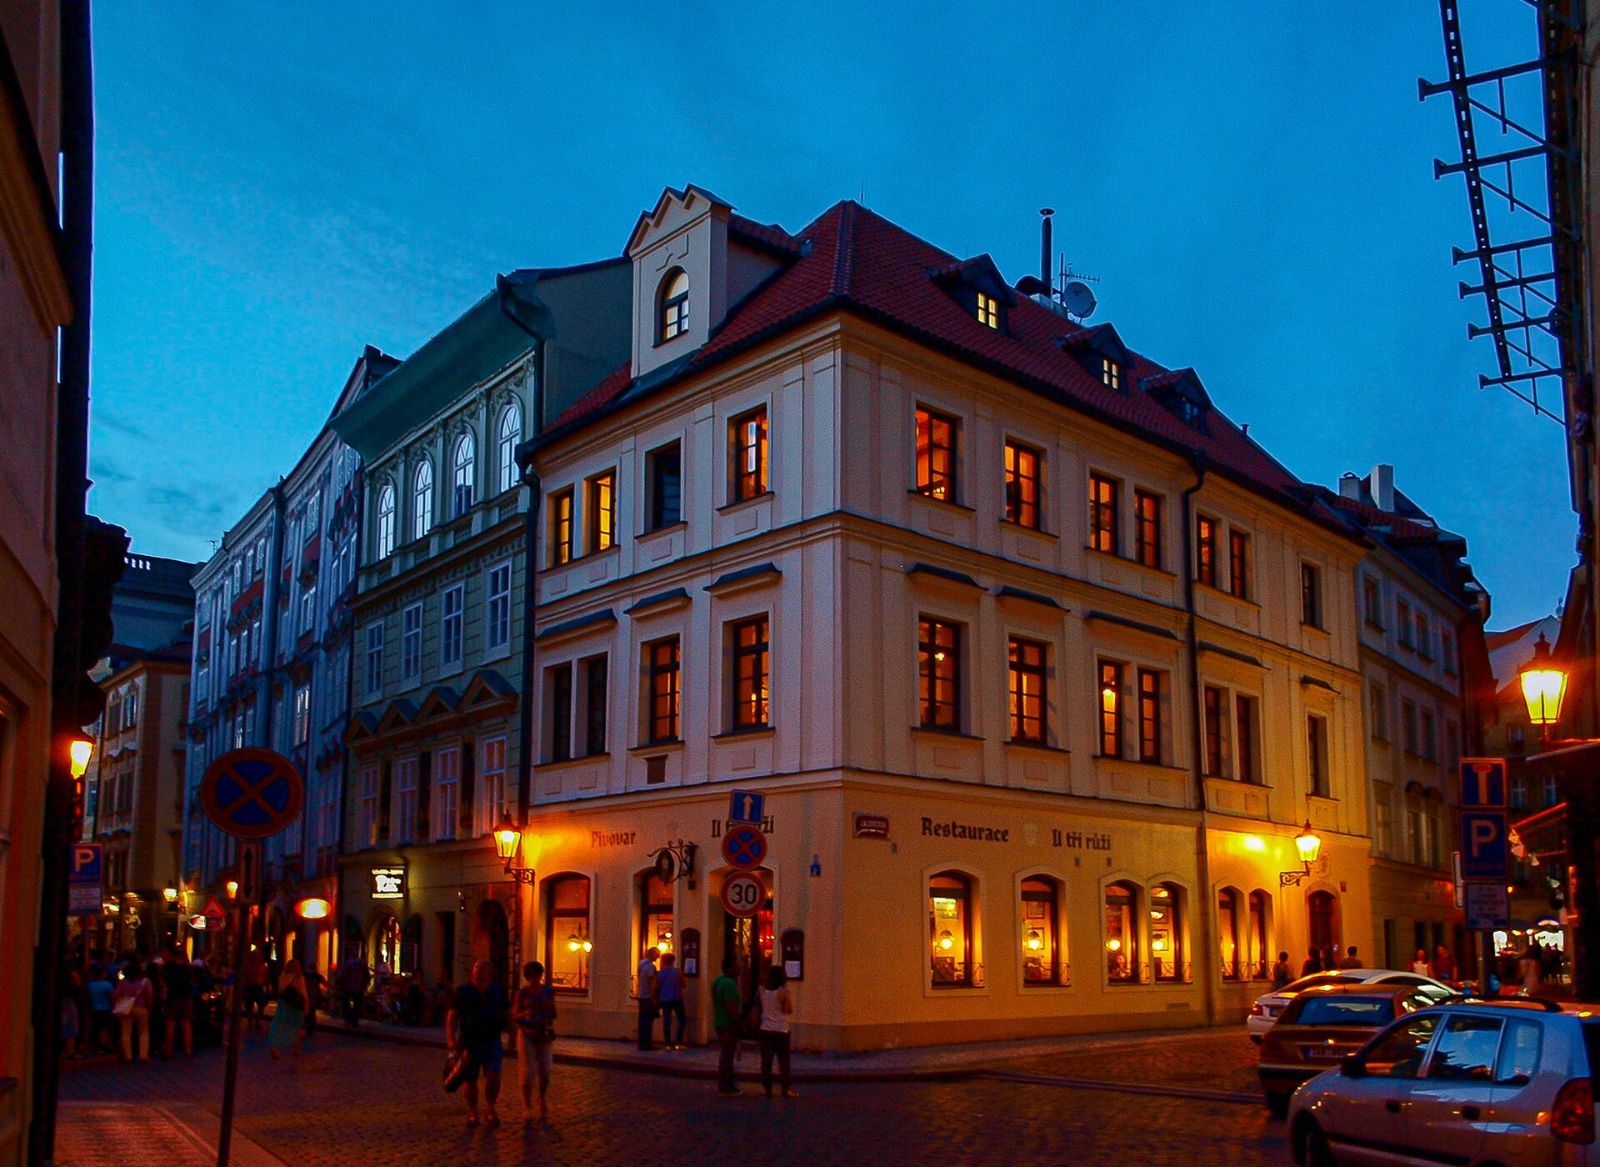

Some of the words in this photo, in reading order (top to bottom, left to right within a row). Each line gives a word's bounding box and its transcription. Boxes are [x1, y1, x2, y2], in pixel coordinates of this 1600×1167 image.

[591, 830, 636, 849] Pivovar
[921, 816, 1009, 843] Restaurace
[1470, 818, 1499, 859] P
[74, 847, 96, 873] P
[731, 883, 757, 905] 30
